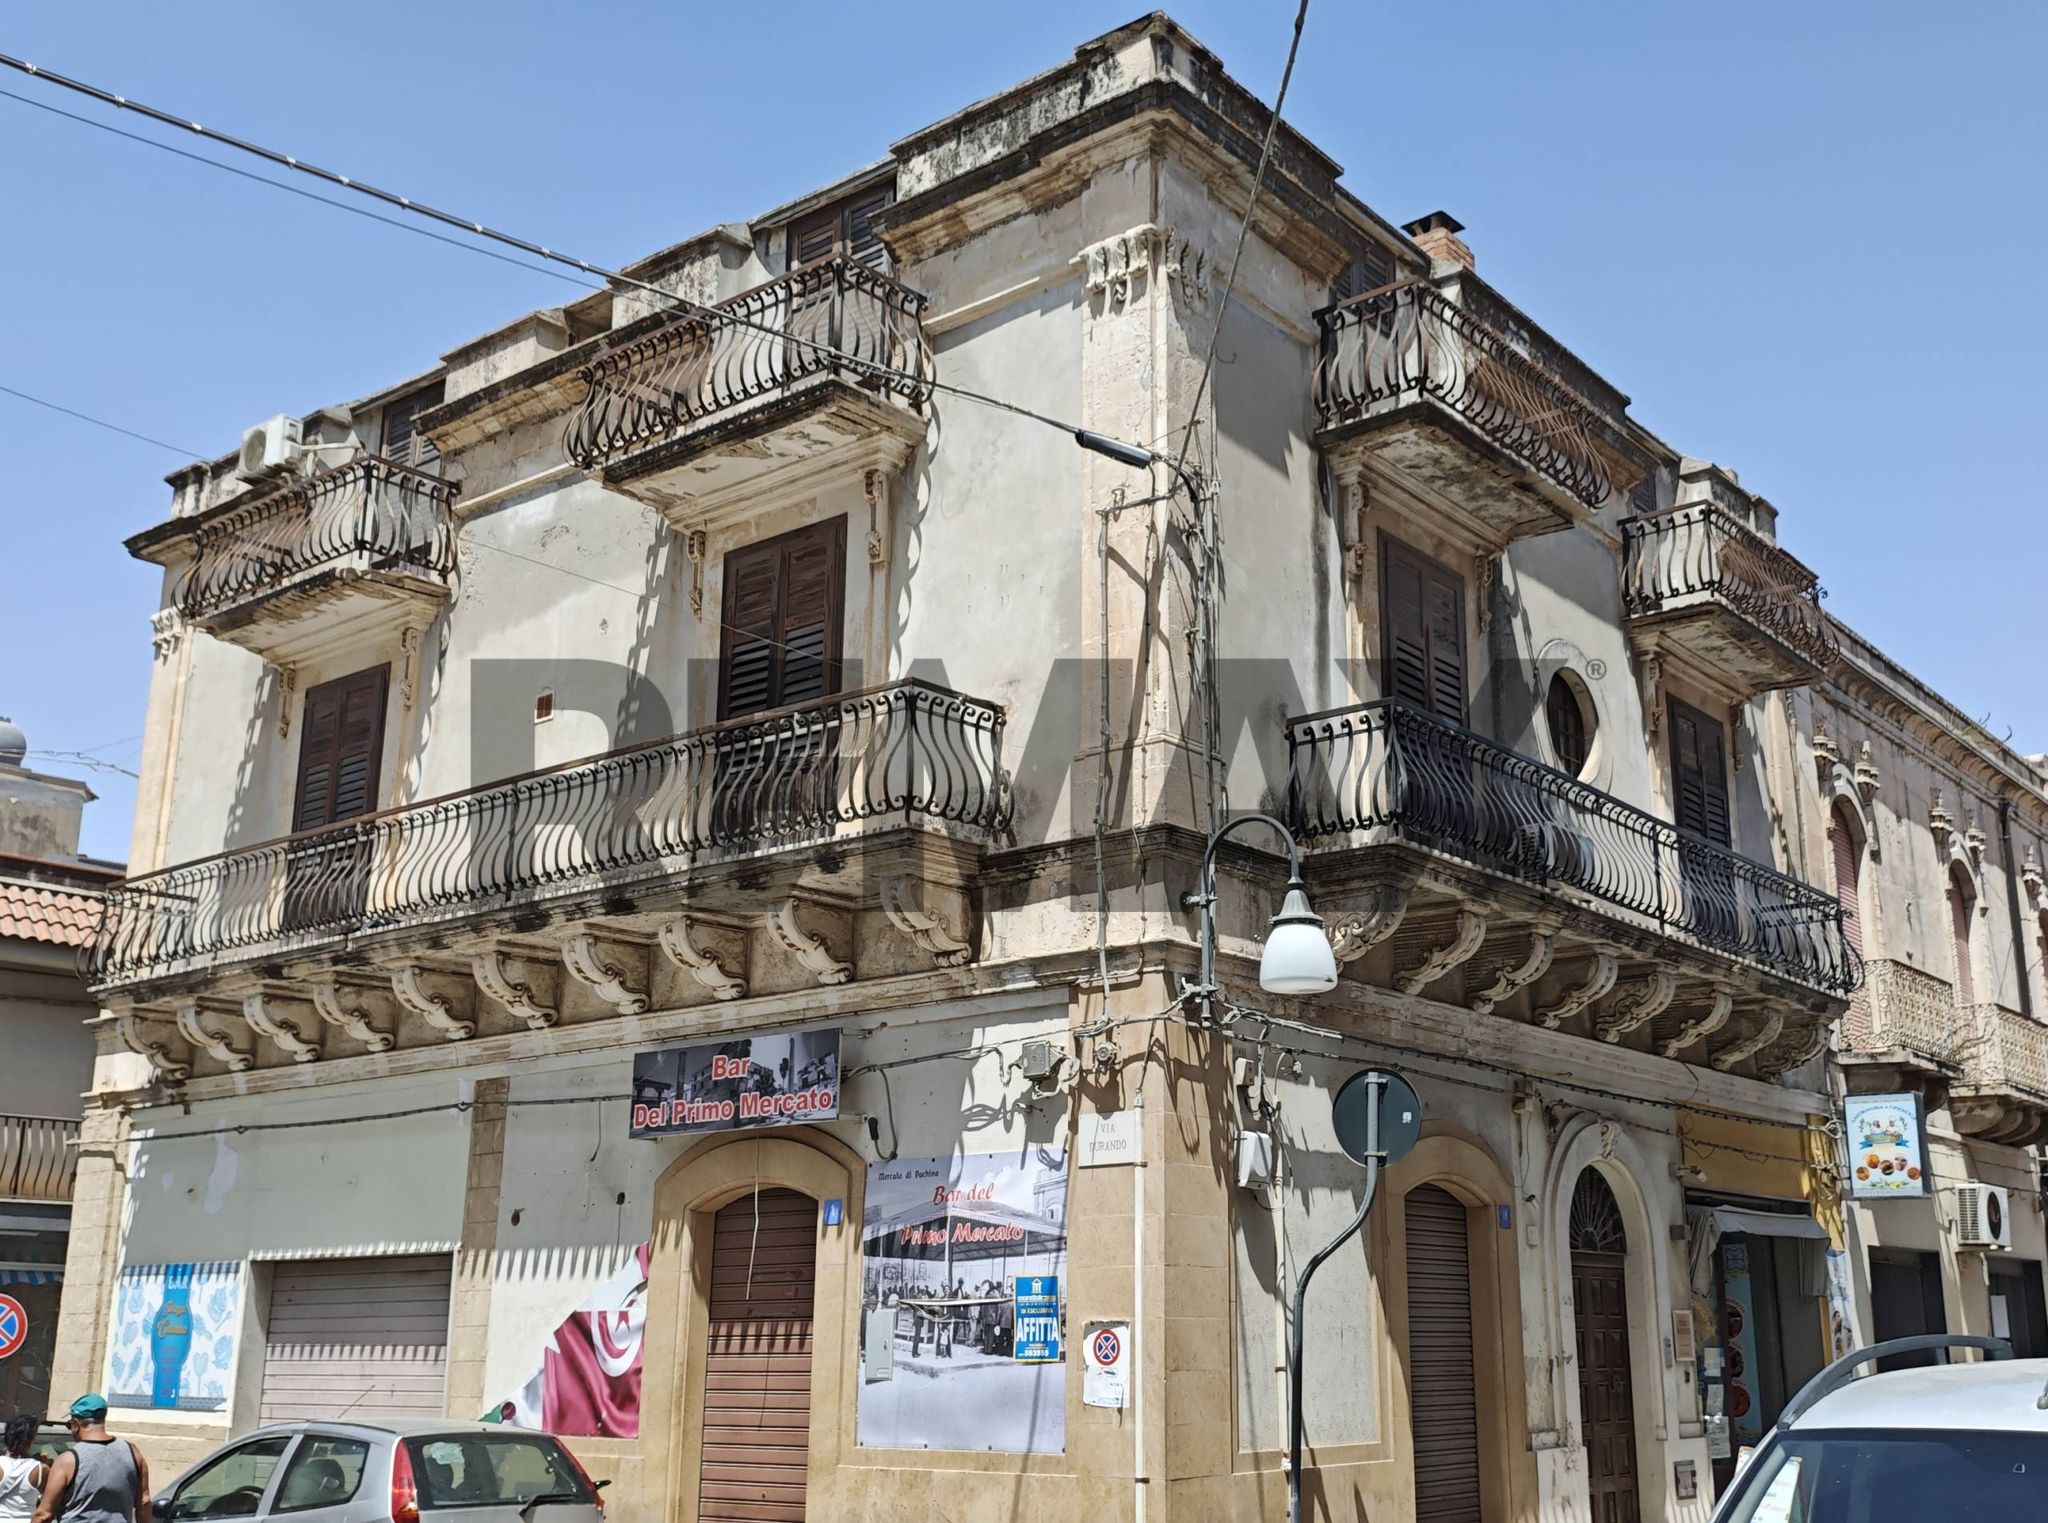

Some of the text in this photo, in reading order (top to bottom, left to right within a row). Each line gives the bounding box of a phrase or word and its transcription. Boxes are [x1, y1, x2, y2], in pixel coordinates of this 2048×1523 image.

[712, 1055, 750, 1080] Bar
[633, 1086, 832, 1128] Del Primo Mercato
[1100, 1123, 1115, 1133] VIA
[1089, 1139, 1127, 1152] DURANDO
[933, 1182, 995, 1205] Bar del
[901, 1222, 1024, 1246] Primo Mercato
[1016, 1317, 1058, 1341] AFFITTA
